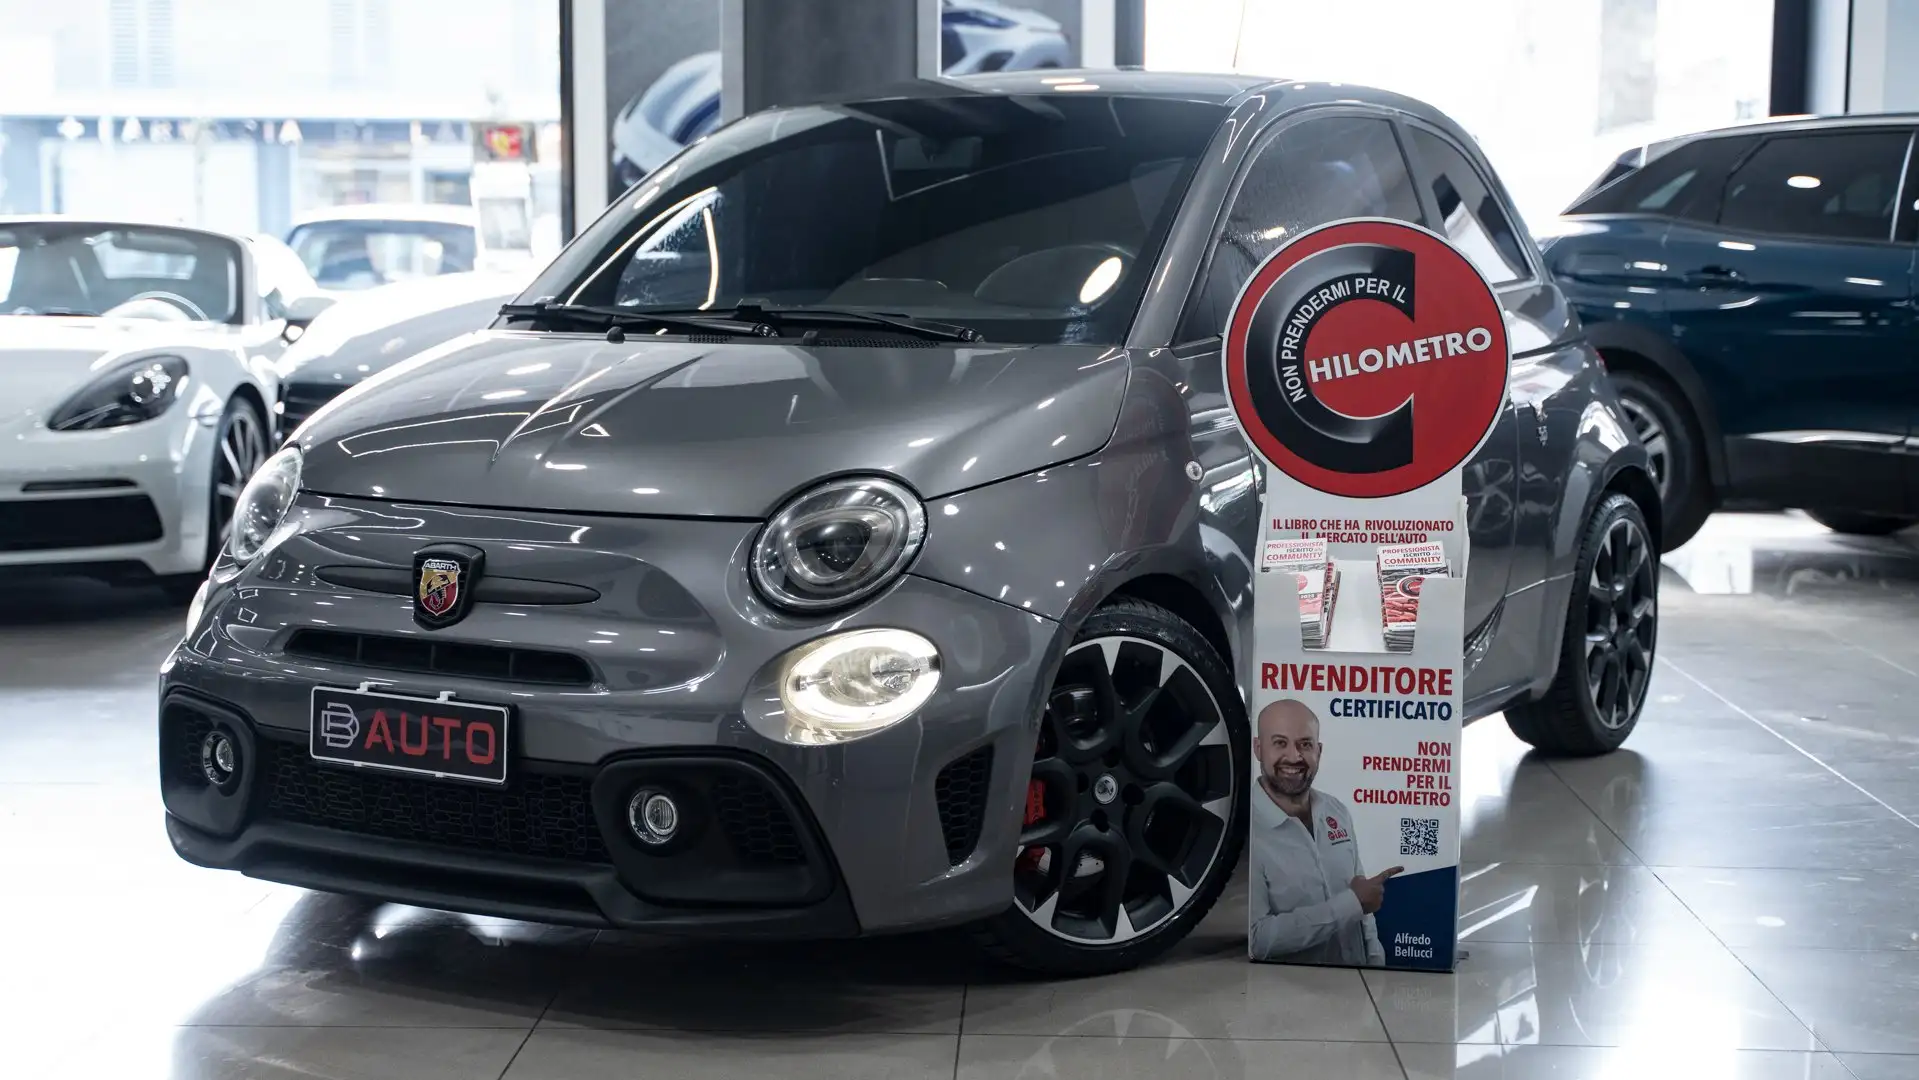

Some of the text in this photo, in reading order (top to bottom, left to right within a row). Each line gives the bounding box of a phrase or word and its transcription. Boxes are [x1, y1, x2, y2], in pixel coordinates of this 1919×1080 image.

[1281, 277, 1407, 403] NON PRENDERMI PER IL
[1308, 327, 1492, 383] HILOMETRO
[1272, 519, 1454, 532] IL LIBRO CHE HA RIVOLUZIONATO
[1266, 541, 1324, 549] PROFESSIONISTA
[1315, 532, 1368, 544] MERCATO
[1370, 532, 1428, 544] DELL'AUTO
[1266, 552, 1323, 561] COMMUNITY
[1382, 545, 1441, 555] PROFESSIONISTA
[425, 562, 457, 570] ABARTH
[1384, 556, 1441, 565] COMMUNITY
[1261, 663, 1453, 696] RIVENDITORE
[1329, 697, 1453, 721] CERTIFICATO
[364, 709, 496, 765] AUTO
[1417, 741, 1452, 757] NON
[1363, 756, 1451, 773] PRENDERMI
[1407, 774, 1452, 790] PER IL
[1353, 788, 1451, 807] CHILOMETRO
[1394, 932, 1431, 945] Alfredo
[1394, 946, 1433, 959] Bellucci
